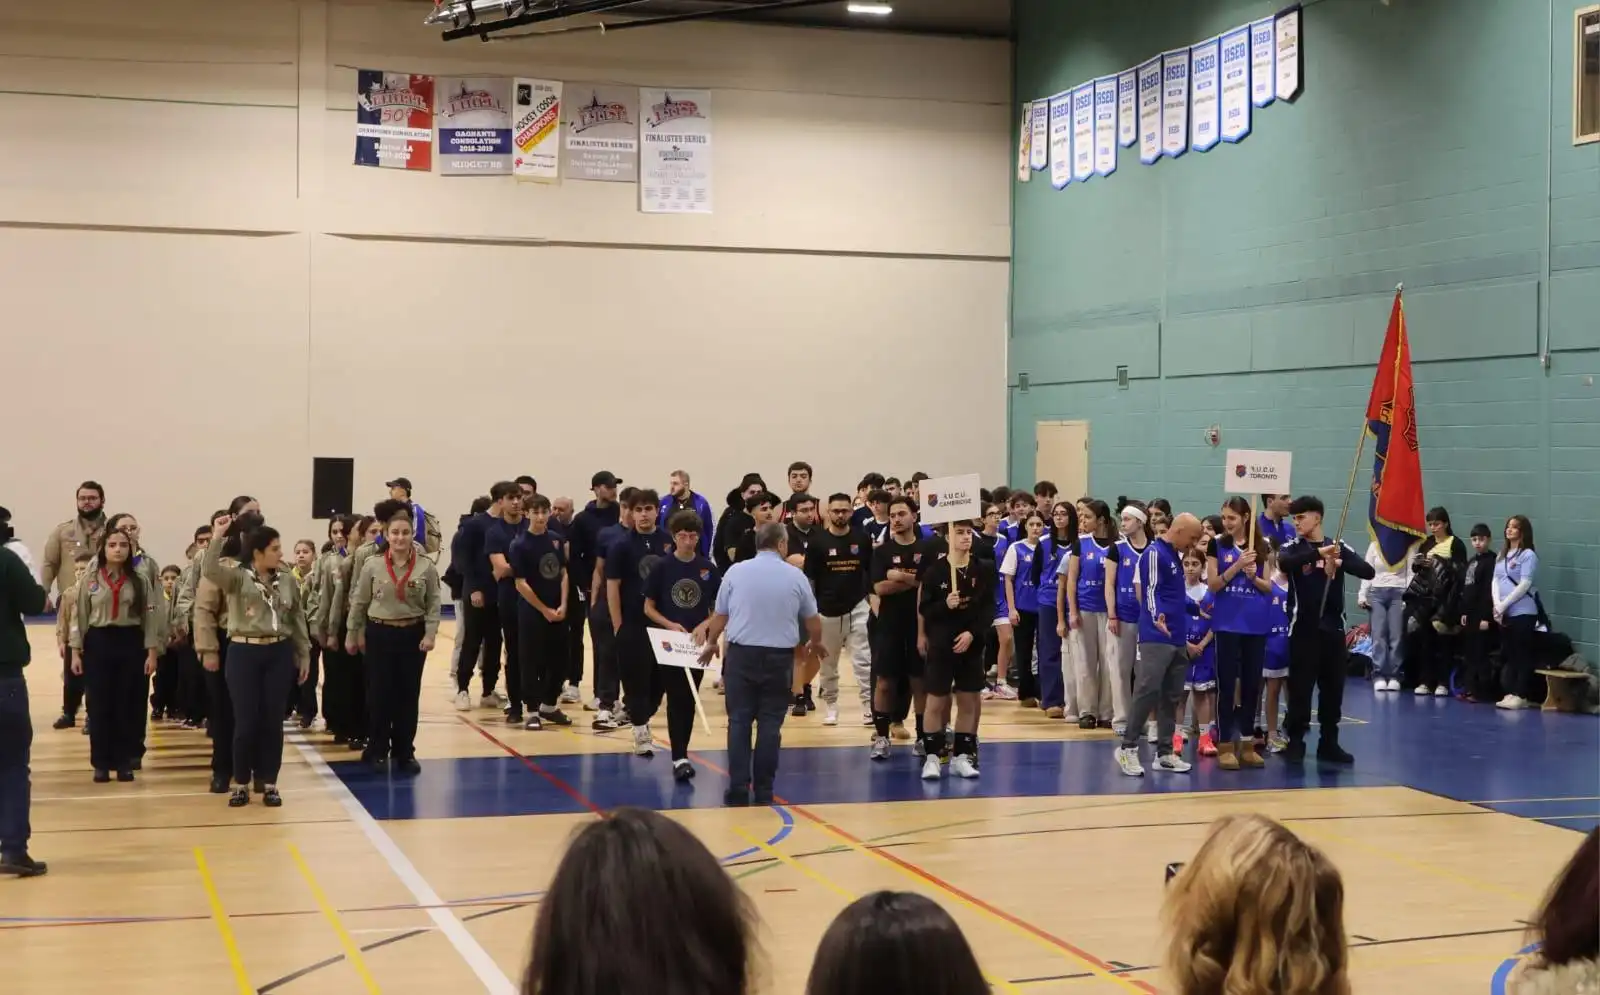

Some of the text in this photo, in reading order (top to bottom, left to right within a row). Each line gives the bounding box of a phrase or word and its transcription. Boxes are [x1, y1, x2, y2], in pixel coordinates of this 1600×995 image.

[1166, 63, 1186, 82] RSEQ
[516, 109, 538, 132] HOCKEY
[516, 110, 556, 146] CHAMPIONS
[570, 139, 609, 148] FINALISTES
[645, 133, 683, 143] FINALISTES
[939, 497, 972, 507] CAMBRIDGE
